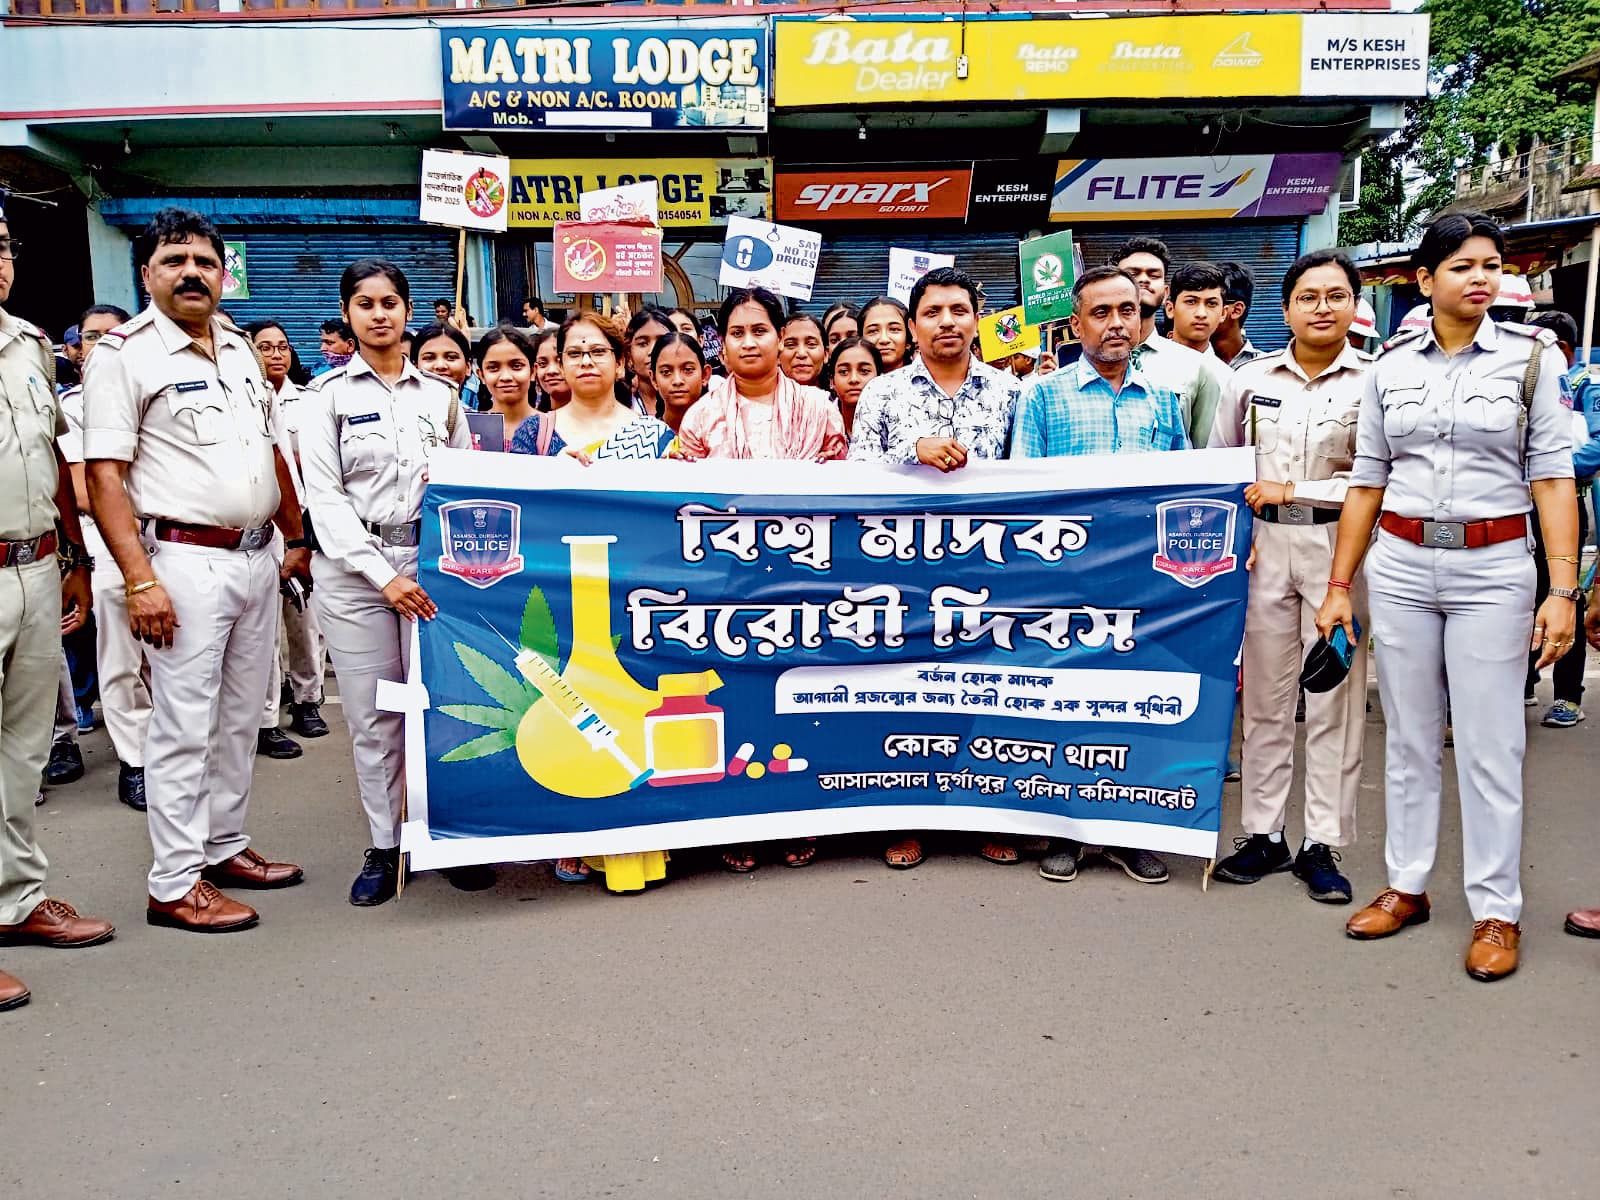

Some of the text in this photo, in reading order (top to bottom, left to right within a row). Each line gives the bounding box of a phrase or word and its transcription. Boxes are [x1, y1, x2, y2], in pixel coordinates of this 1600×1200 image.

[804, 27, 953, 65] Bata
[1017, 44, 1080, 60] Bata
[1110, 41, 1182, 60] Bata
[1327, 39, 1405, 53] M/S KESH
[449, 37, 758, 85] MATRI LODGE
[1025, 60, 1070, 73] REMO
[1311, 58, 1421, 71] ENTERPRISES
[855, 67, 954, 93] Dealer
[468, 91, 677, 109] A/C & NON A/C. ROOM
[493, 112, 534, 125] Mob.
[510, 176, 583, 203] ATRI
[997, 184, 1029, 193] KESH
[1087, 174, 1205, 200] FLITE
[1287, 177, 1315, 186] KESH
[975, 193, 1048, 203] ENTERPRISE
[1266, 186, 1330, 195] ENTERPRISE
[518, 211, 540, 221] NON
[784, 246, 817, 260] NO TO
[798, 239, 819, 251] SAY
[776, 253, 815, 269] DRUGS
[677, 504, 1093, 570] বিশ্ব মাদক
[1169, 539, 1222, 550] POLICE
[454, 540, 509, 551] POLICE
[626, 585, 1141, 658] বিরোধী দিবস
[917, 665, 1054, 689] বর্জন হোক মাদক
[792, 685, 849, 705] আগামী
[922, 692, 955, 707] জন্য
[961, 688, 998, 707] তৈরী
[1004, 696, 1046, 711] হোক
[1051, 699, 1080, 713] এক
[1086, 699, 1128, 718] সুন্দর
[1134, 695, 1182, 720] পৃথিবী
[884, 733, 1129, 770] কোক ওভেন থানা
[818, 768, 1197, 810] আসানসোল দুর্গাপুর পুলিশ কমিশনারেট
